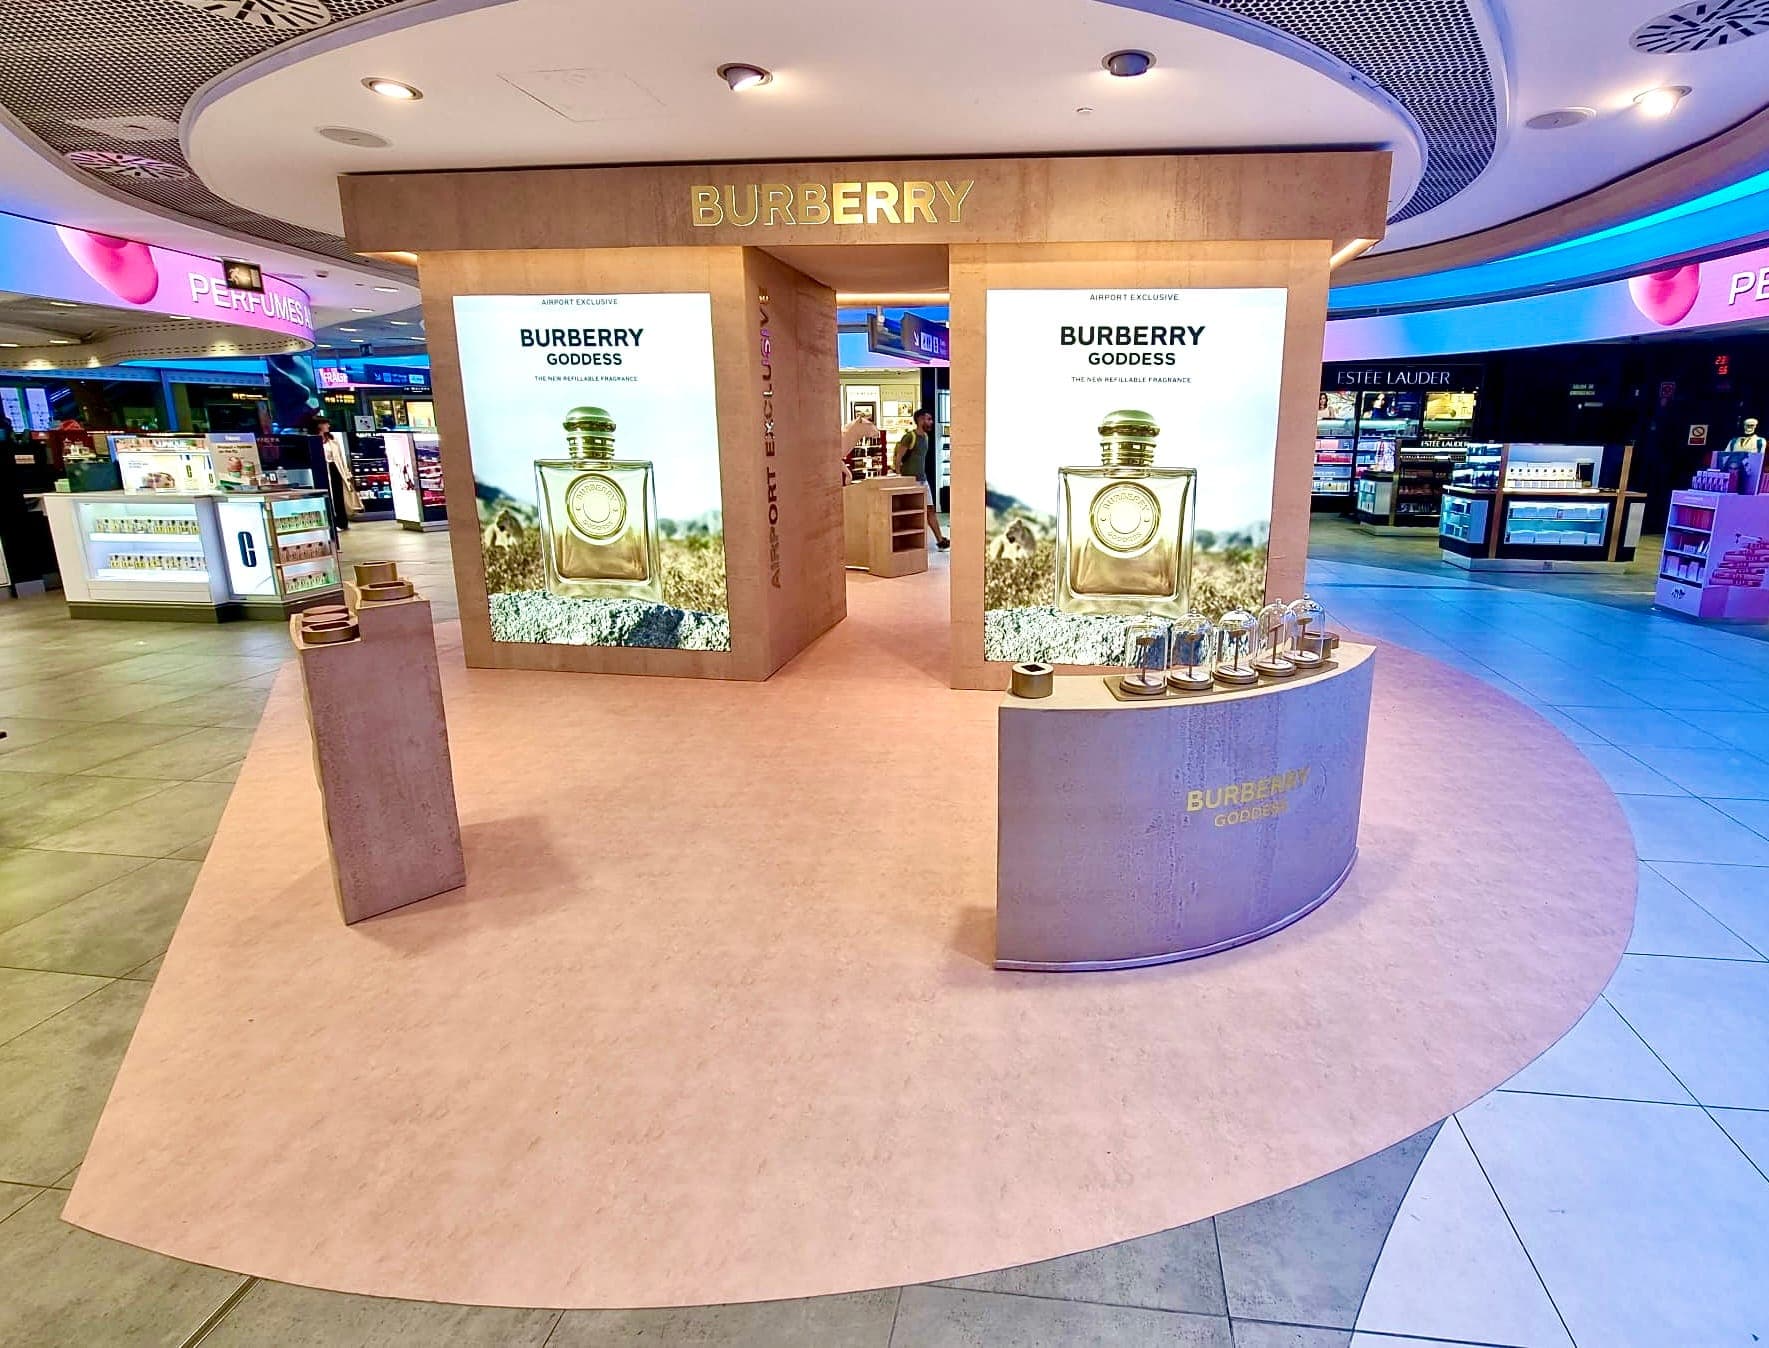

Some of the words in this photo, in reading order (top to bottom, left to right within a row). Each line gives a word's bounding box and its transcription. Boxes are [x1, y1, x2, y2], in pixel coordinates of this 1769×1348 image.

[690, 180, 975, 227] BURBERRY
[541, 298, 574, 306] AIRPORT
[576, 298, 618, 306] EXCLUSIVE
[1090, 293, 1128, 301] AIRPORT
[1130, 293, 1180, 301] EXCLUSIVE
[520, 328, 644, 347] BURBERRY
[1060, 325, 1206, 346] BURBERRY
[546, 353, 622, 366] GODDESS
[1088, 352, 1176, 366] GODDESS
[759, 287, 776, 457] EXCLUSIVE
[1387, 371, 1450, 385] LAUDER
[766, 466, 781, 589] AIRPORT
[1186, 763, 1312, 812] BURBERRY
[1214, 798, 1289, 827] GODDESS
